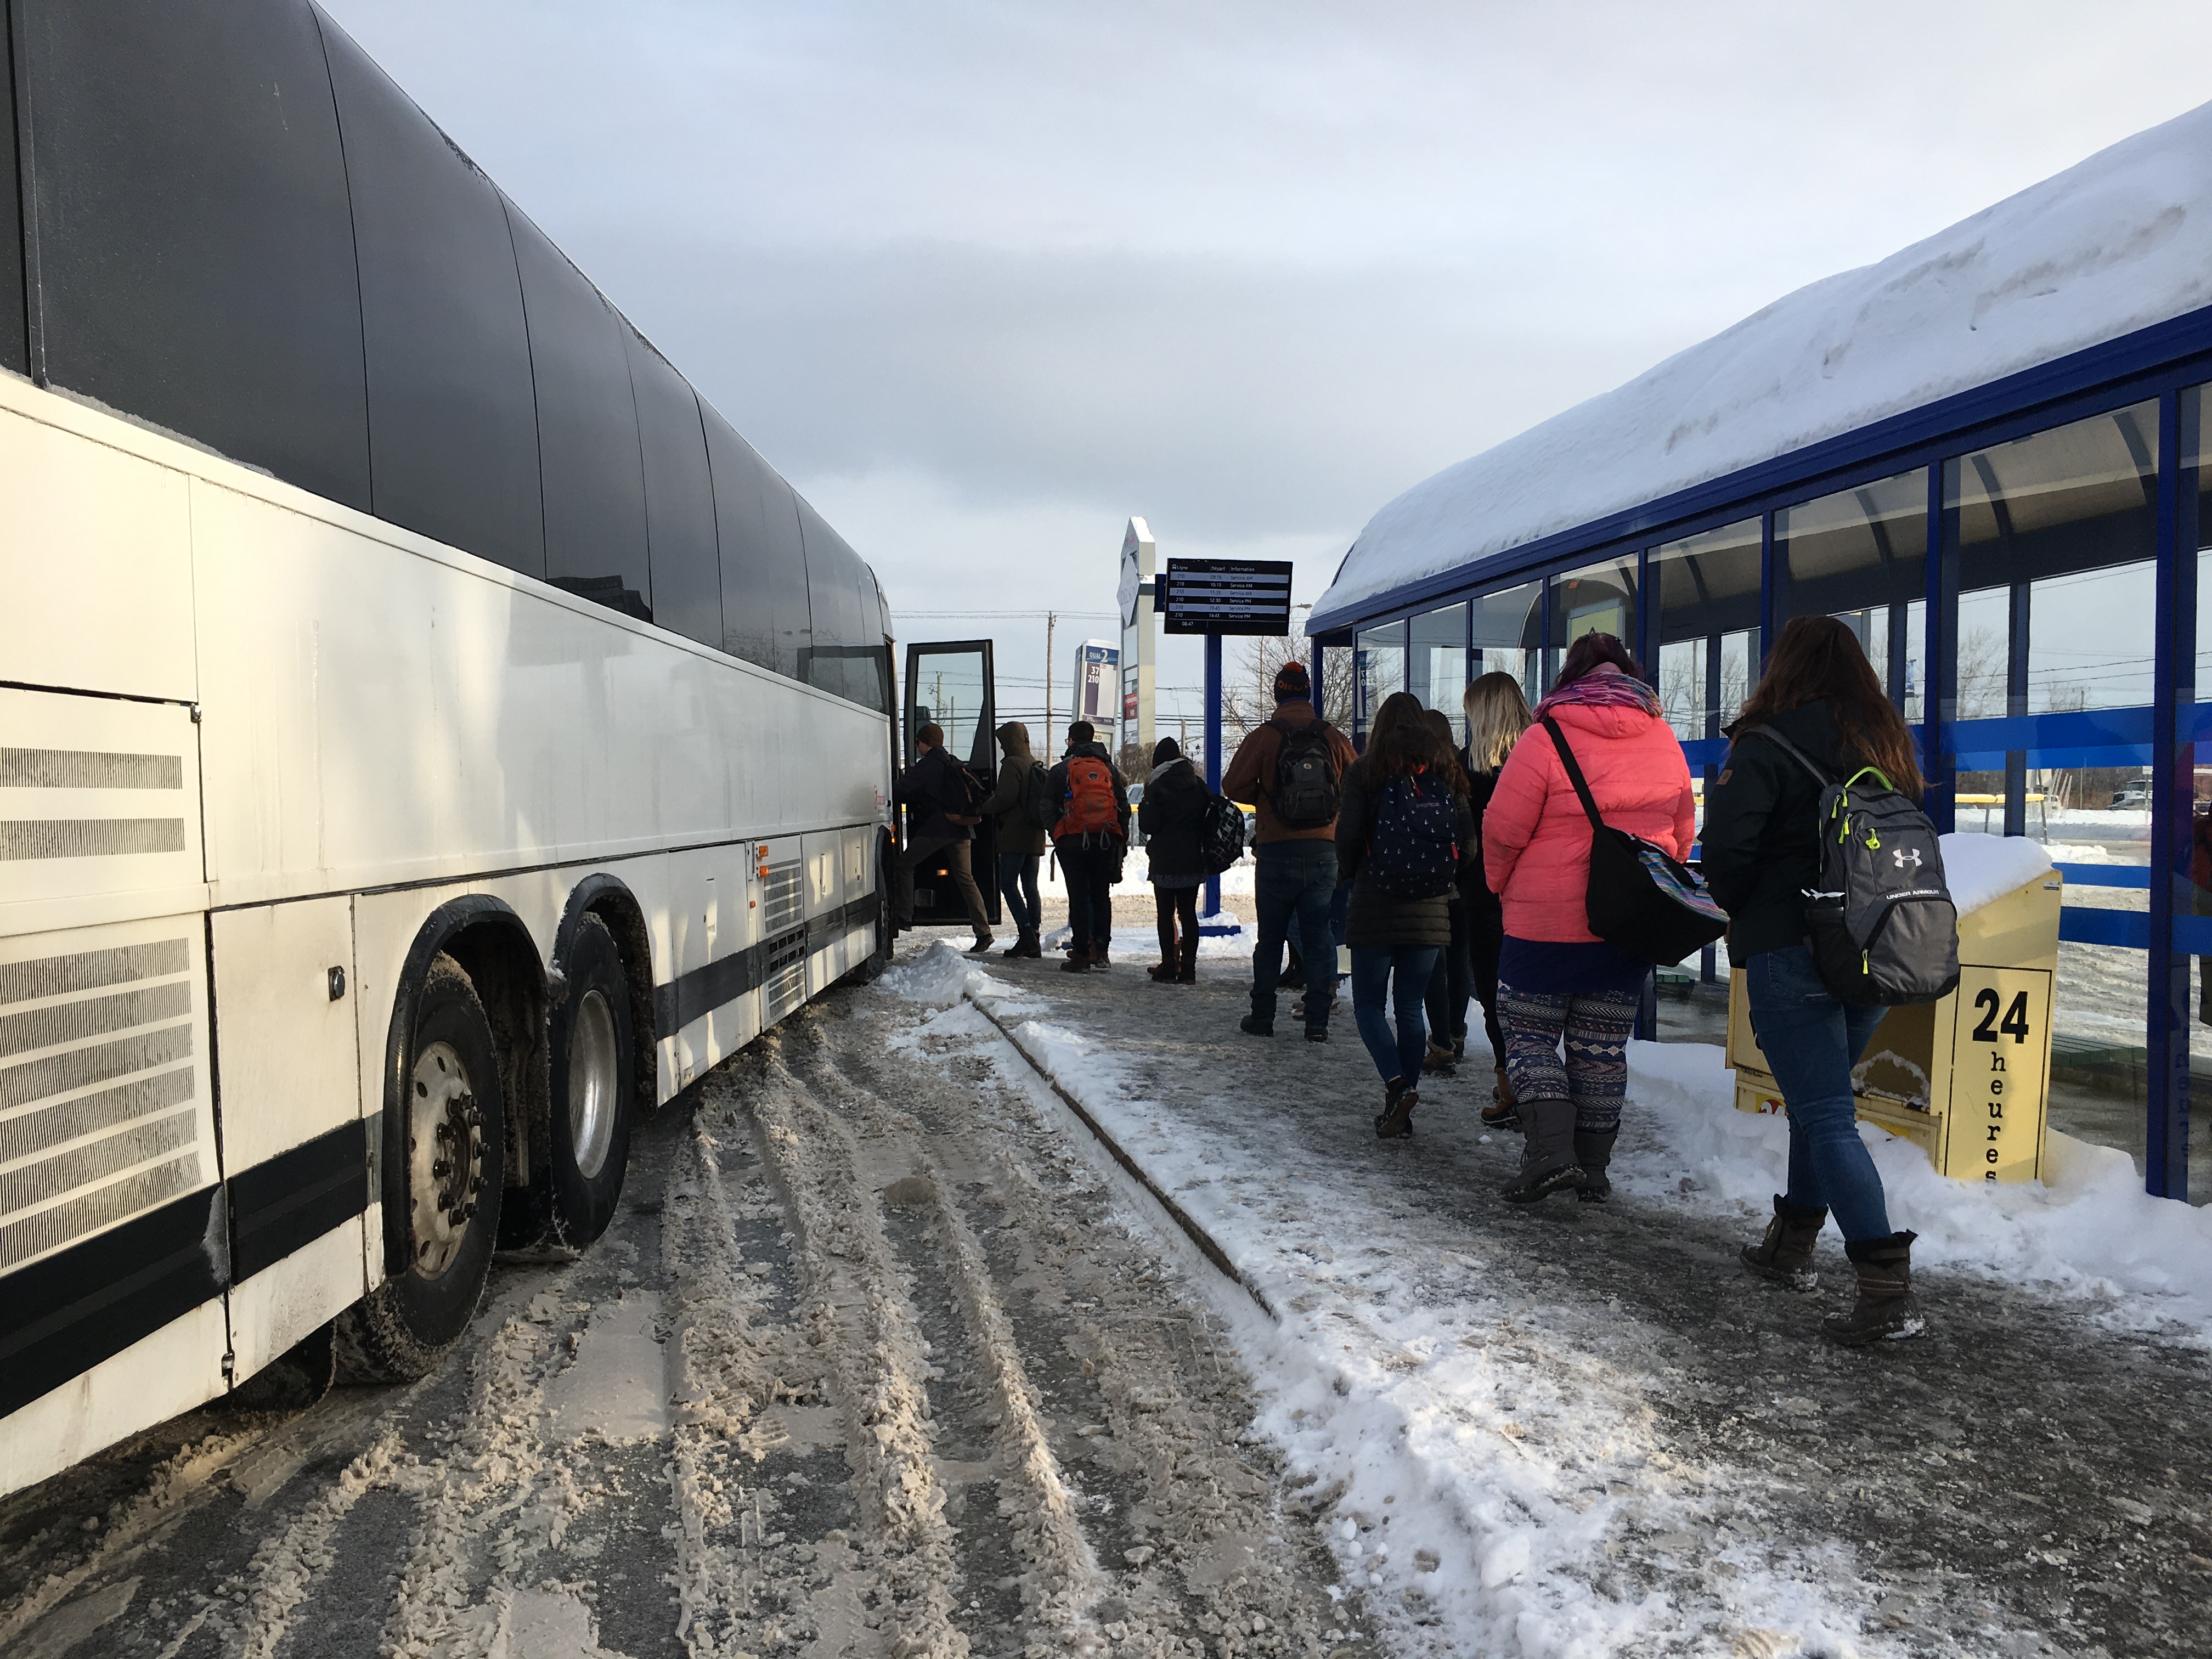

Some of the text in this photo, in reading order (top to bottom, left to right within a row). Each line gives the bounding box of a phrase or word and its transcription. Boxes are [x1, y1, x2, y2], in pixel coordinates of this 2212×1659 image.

[1101, 649, 1108, 663] 2
[1091, 666, 1099, 675] 37
[1087, 674, 1099, 684] 210
[1886, 891, 1911, 900] UNDER
[1972, 988, 2029, 1045] 24
[1984, 1051, 2006, 1181] heures
